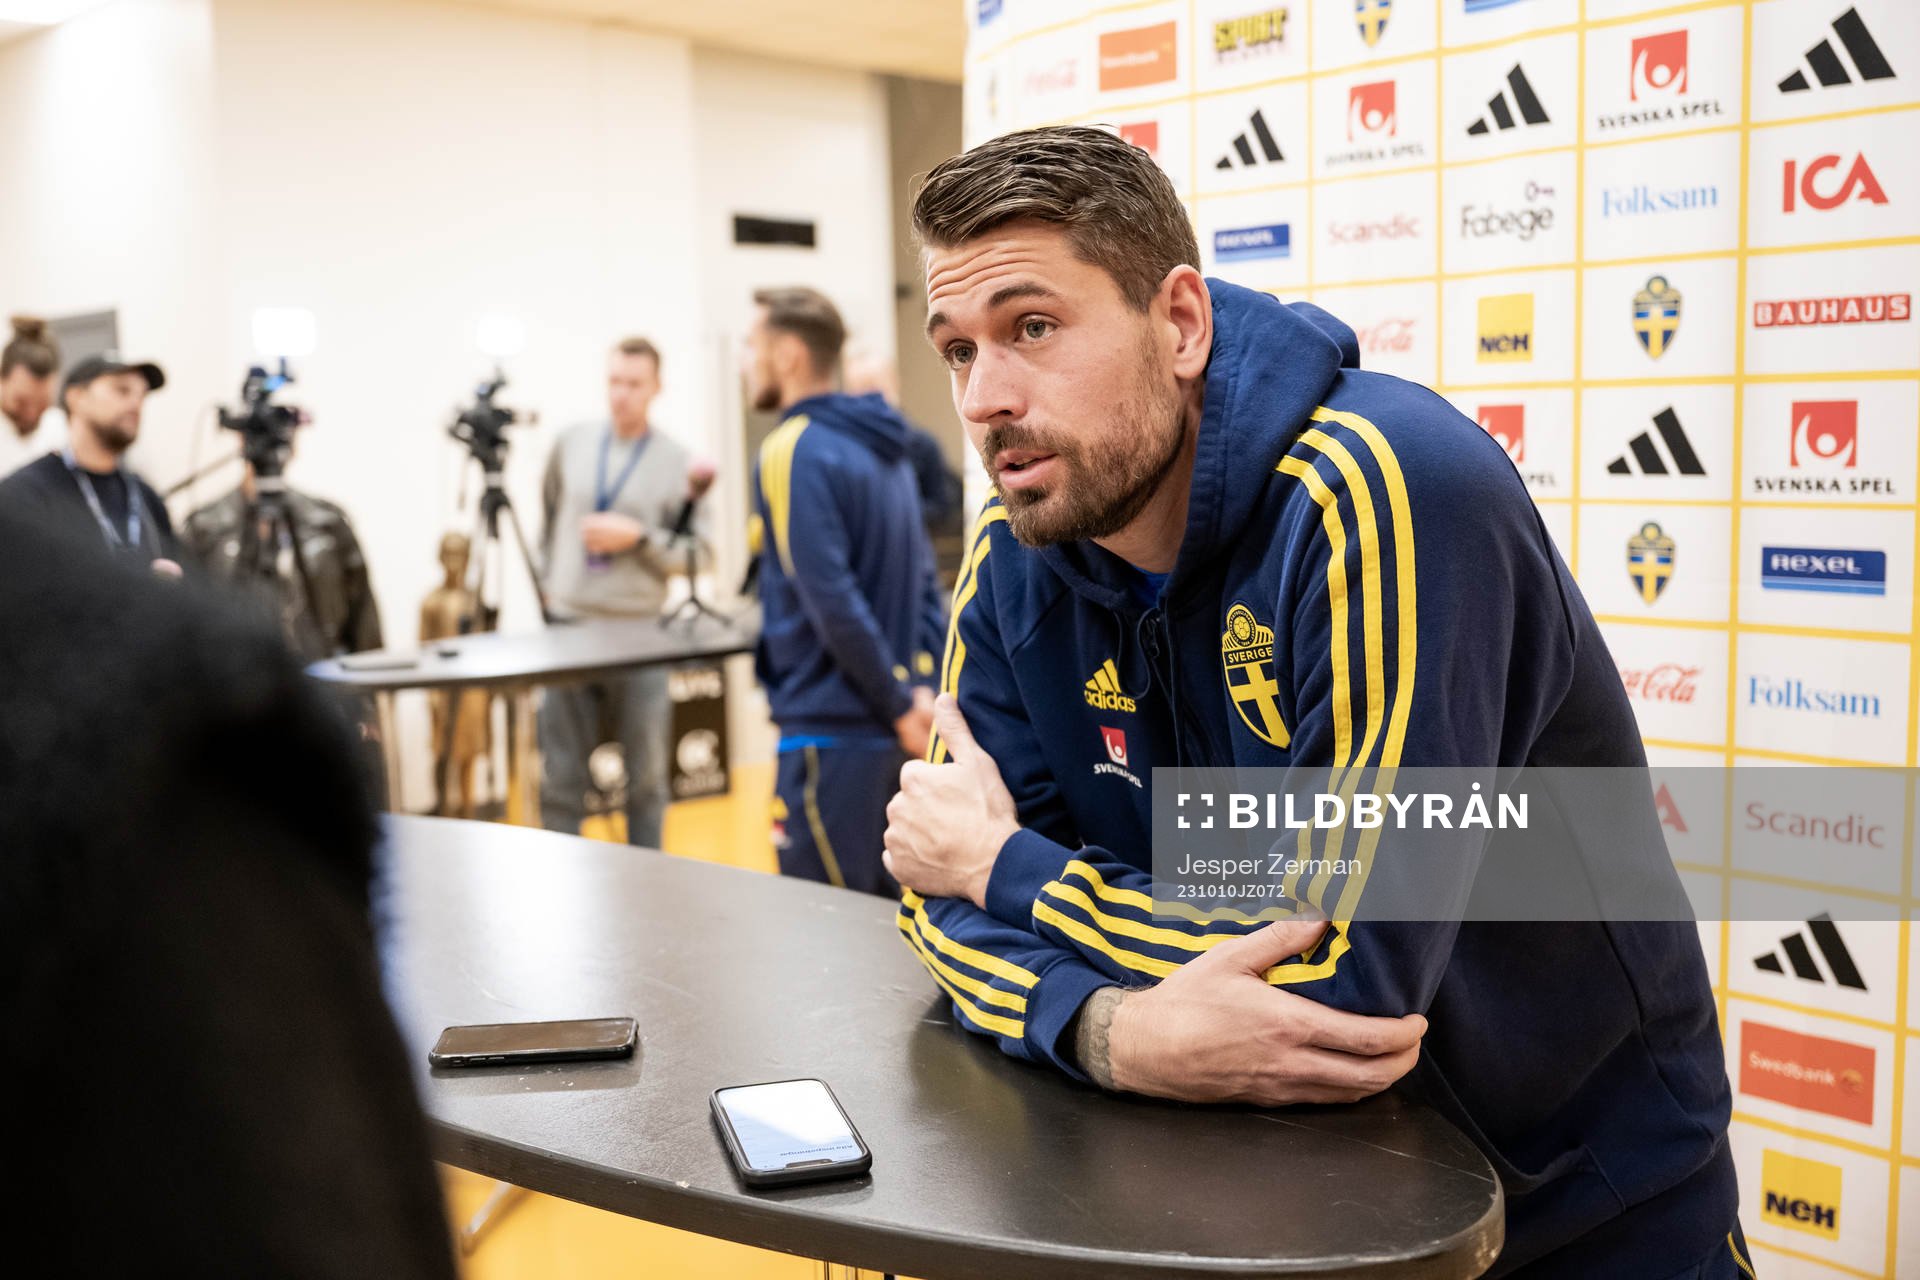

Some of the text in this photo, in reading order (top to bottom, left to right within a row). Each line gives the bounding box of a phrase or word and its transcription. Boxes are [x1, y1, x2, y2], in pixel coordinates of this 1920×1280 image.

[1597, 100, 1722, 130] SVENSKA SPEL
[1783, 151, 1889, 213] ICA
[1602, 185, 1718, 219] Folksam
[1460, 203, 1555, 242] Fabege
[1755, 295, 1910, 327] BAUHAUS
[1754, 476, 1896, 495] SVENSKA SPEL
[1228, 646, 1273, 663] SVERIGE
[1084, 688, 1137, 713] adidas
[1749, 676, 1880, 717] Folksam
[1746, 802, 1885, 849] Scandic
[1749, 1051, 1836, 1087] Swedbank
